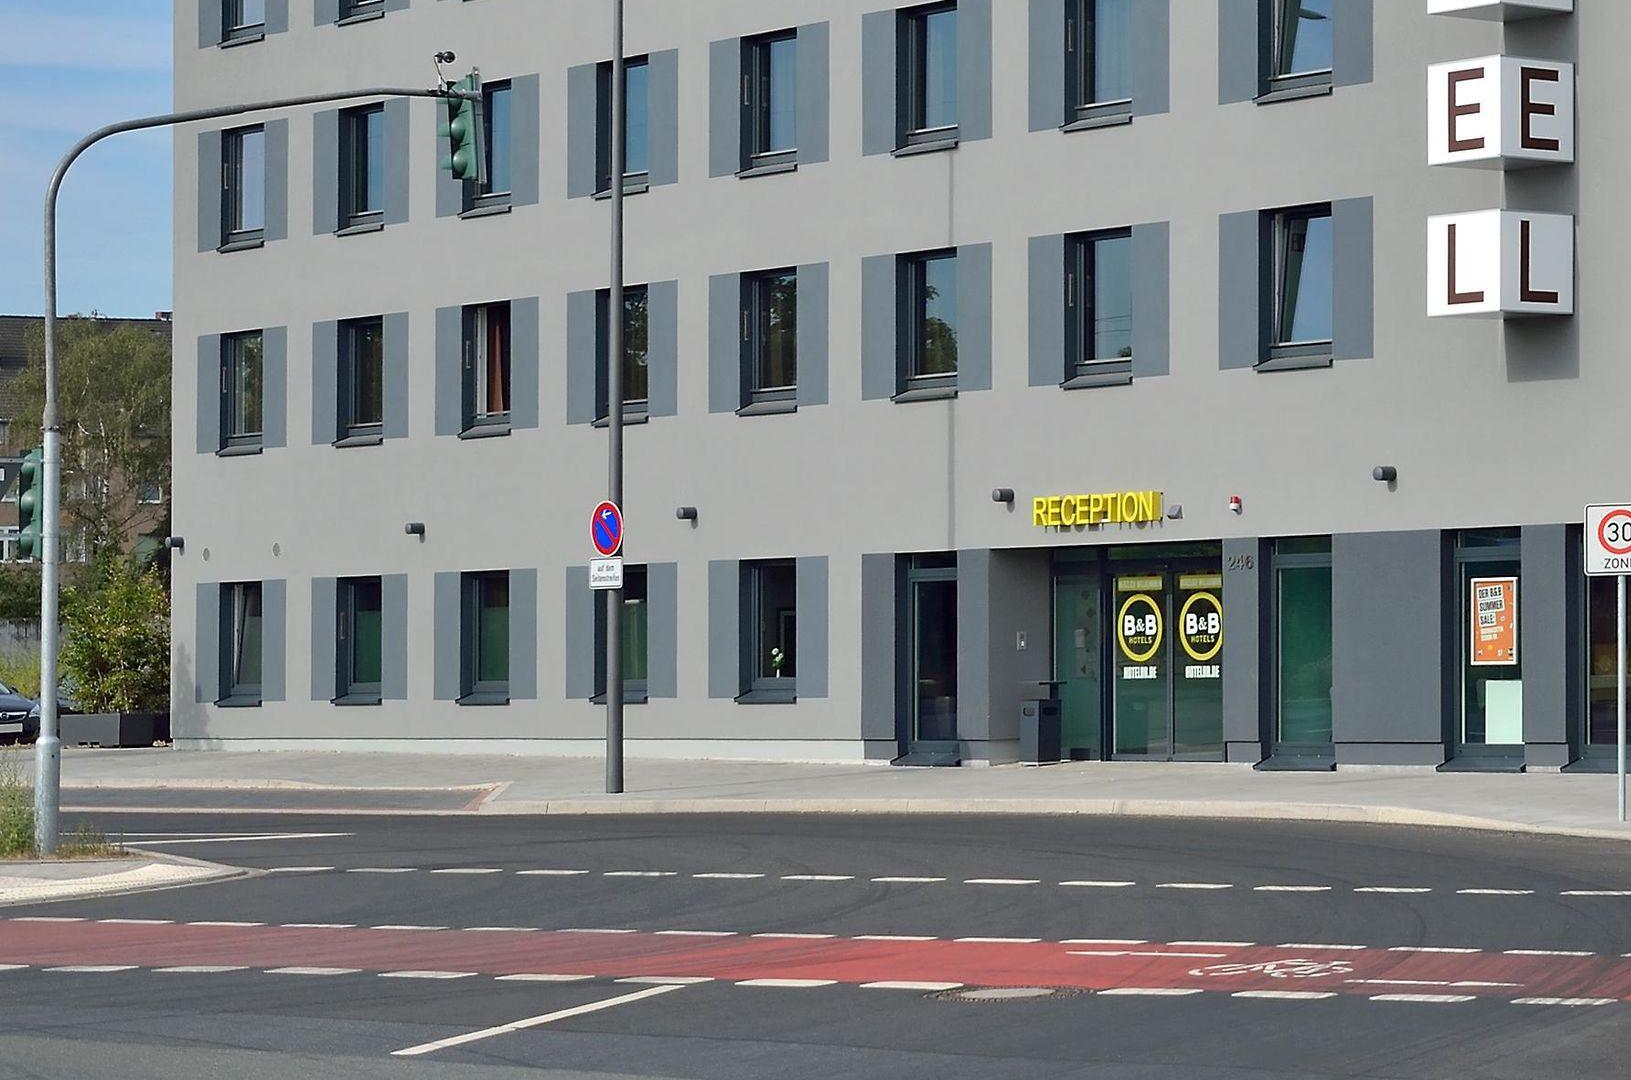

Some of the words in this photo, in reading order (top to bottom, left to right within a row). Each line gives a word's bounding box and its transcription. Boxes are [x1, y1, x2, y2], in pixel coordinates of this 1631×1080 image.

[1033, 491, 1155, 527] RECEPTION
[1227, 555, 1254, 571] 246
[1479, 599, 1503, 612] SUMMER
[1124, 614, 1157, 636] B&B
[1186, 612, 1220, 635] B&B
[1128, 636, 1153, 644] HOTELS
[1190, 634, 1215, 643] HOTELS
